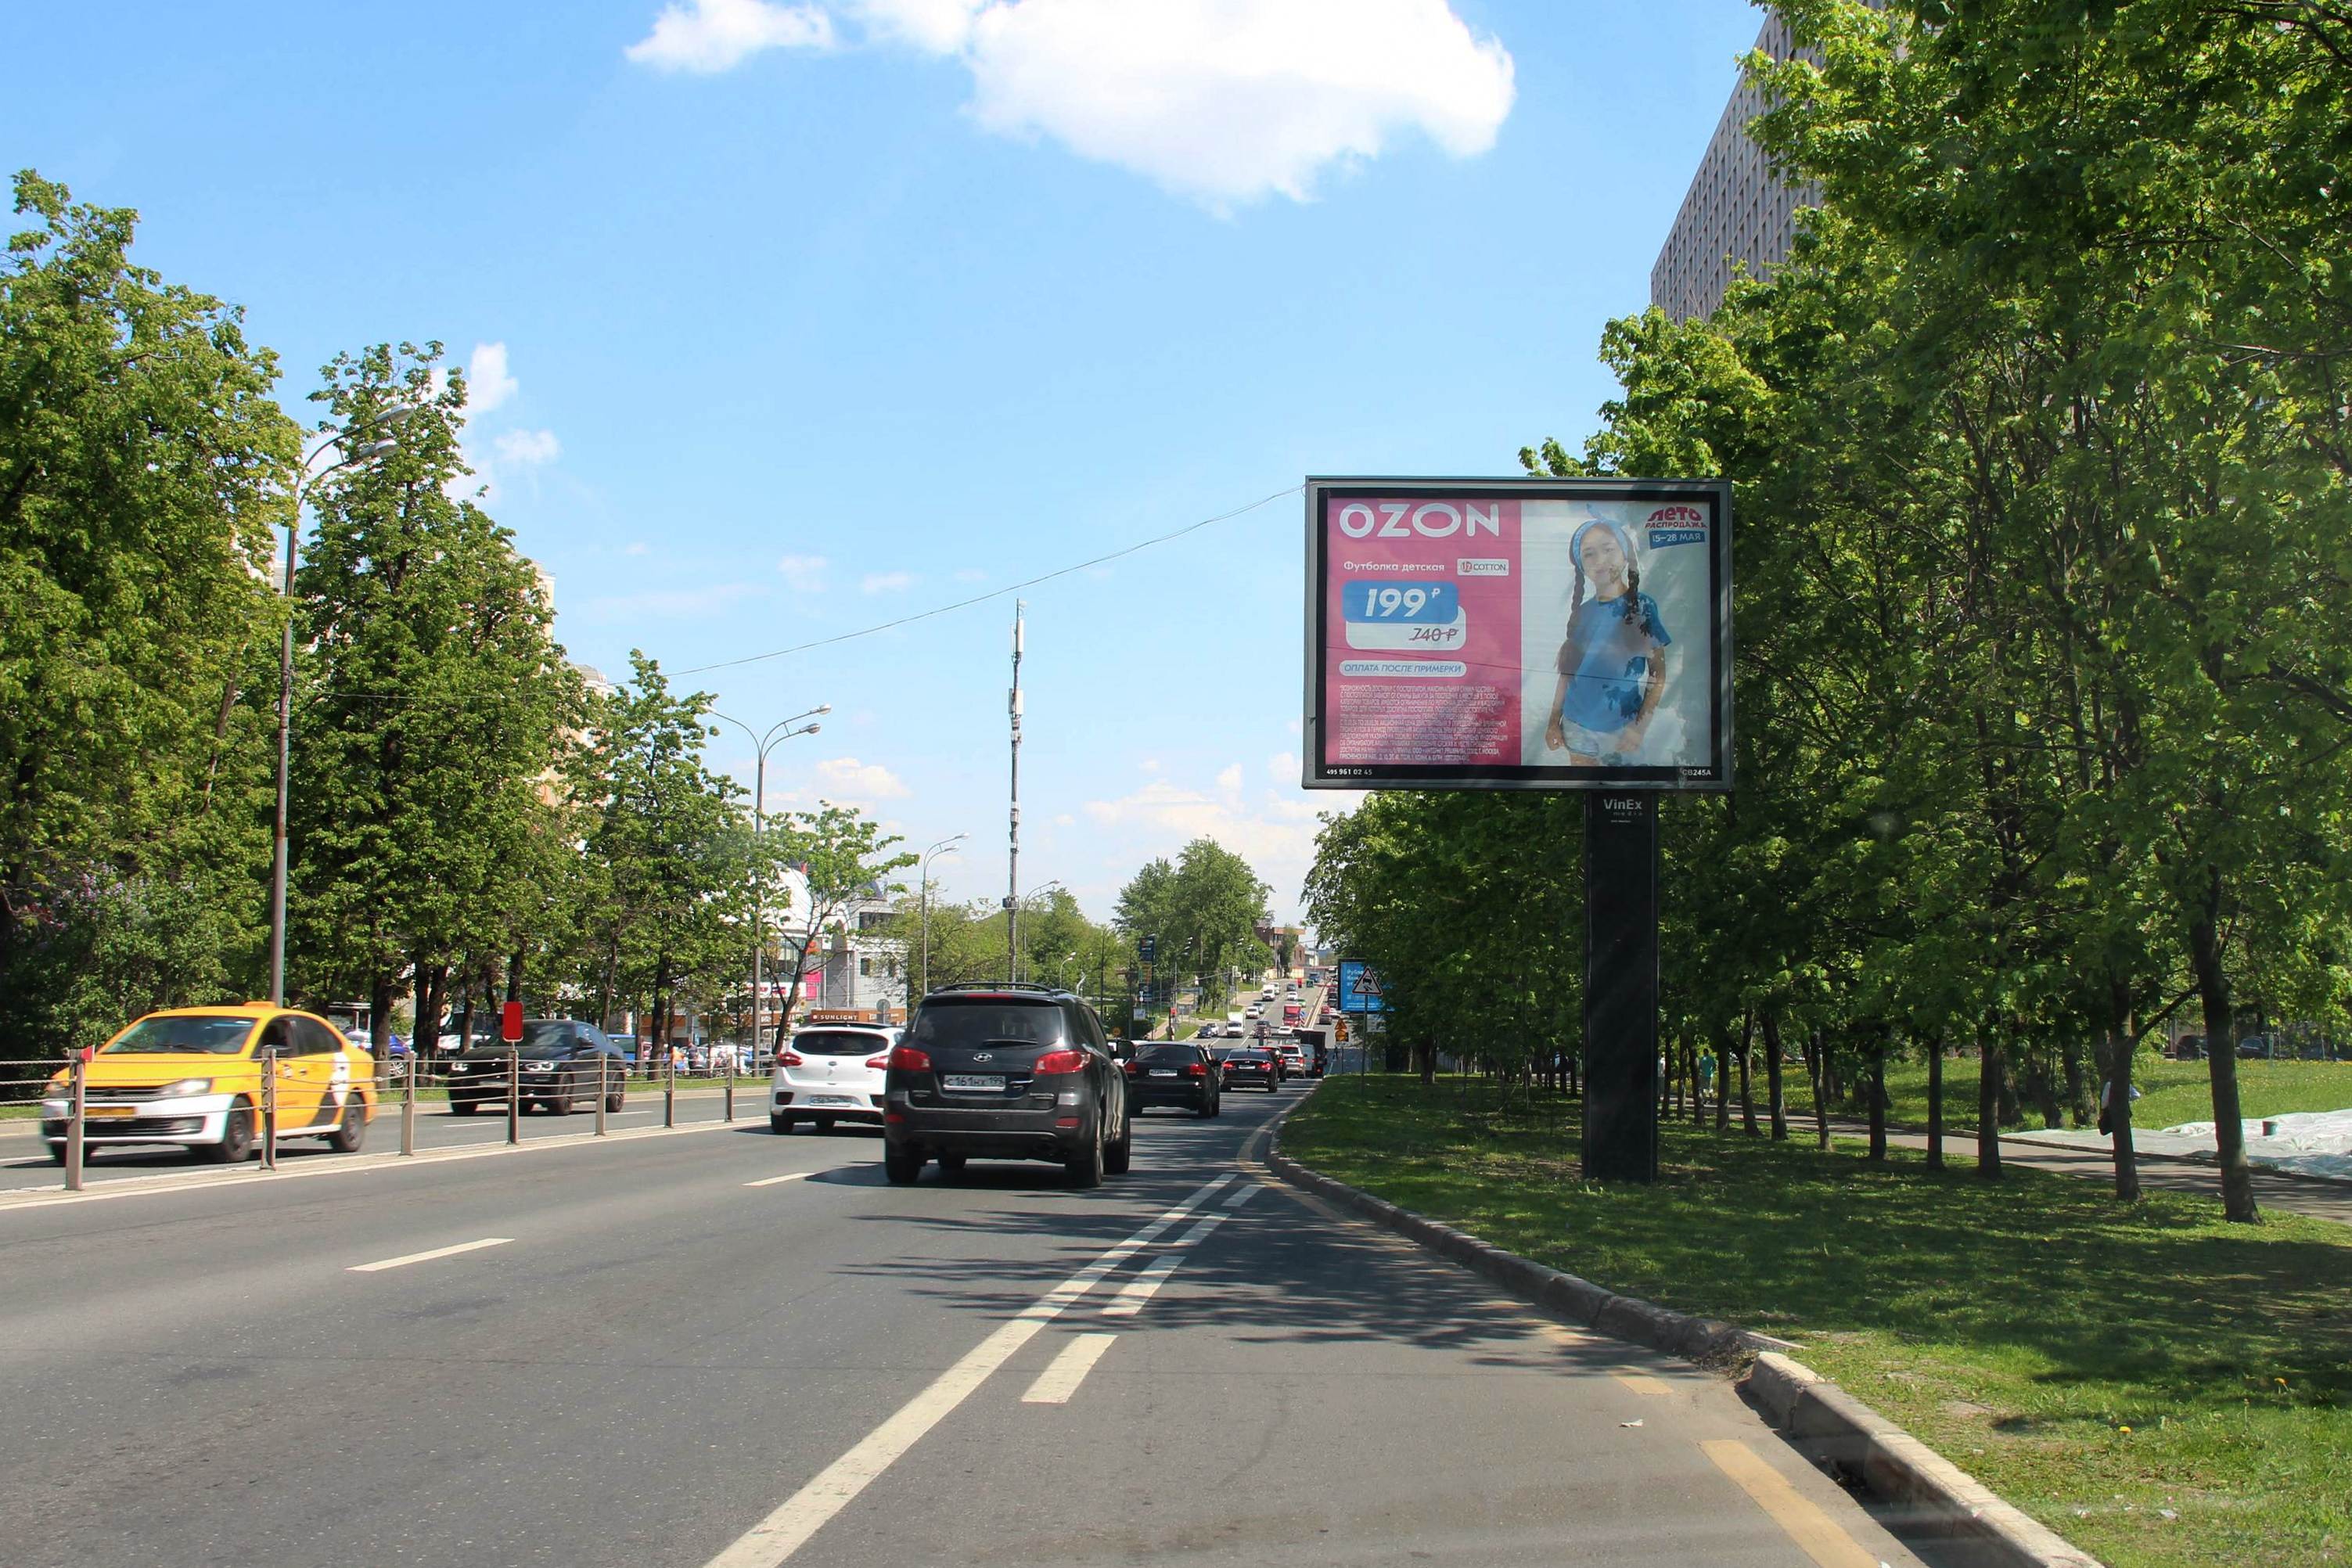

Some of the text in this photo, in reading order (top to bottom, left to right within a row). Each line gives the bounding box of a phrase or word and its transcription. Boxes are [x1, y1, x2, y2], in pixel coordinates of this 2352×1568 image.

[1339, 502, 1500, 538] OZON
[1679, 532, 1701, 541] МАЯ
[1343, 560, 1445, 573] Футболка детская
[1473, 563, 1506, 571] COTTON
[1365, 588, 1426, 617] 199
[1415, 664, 1462, 673] ПРИМЕРКИ
[1603, 799, 1642, 810] VinEx
